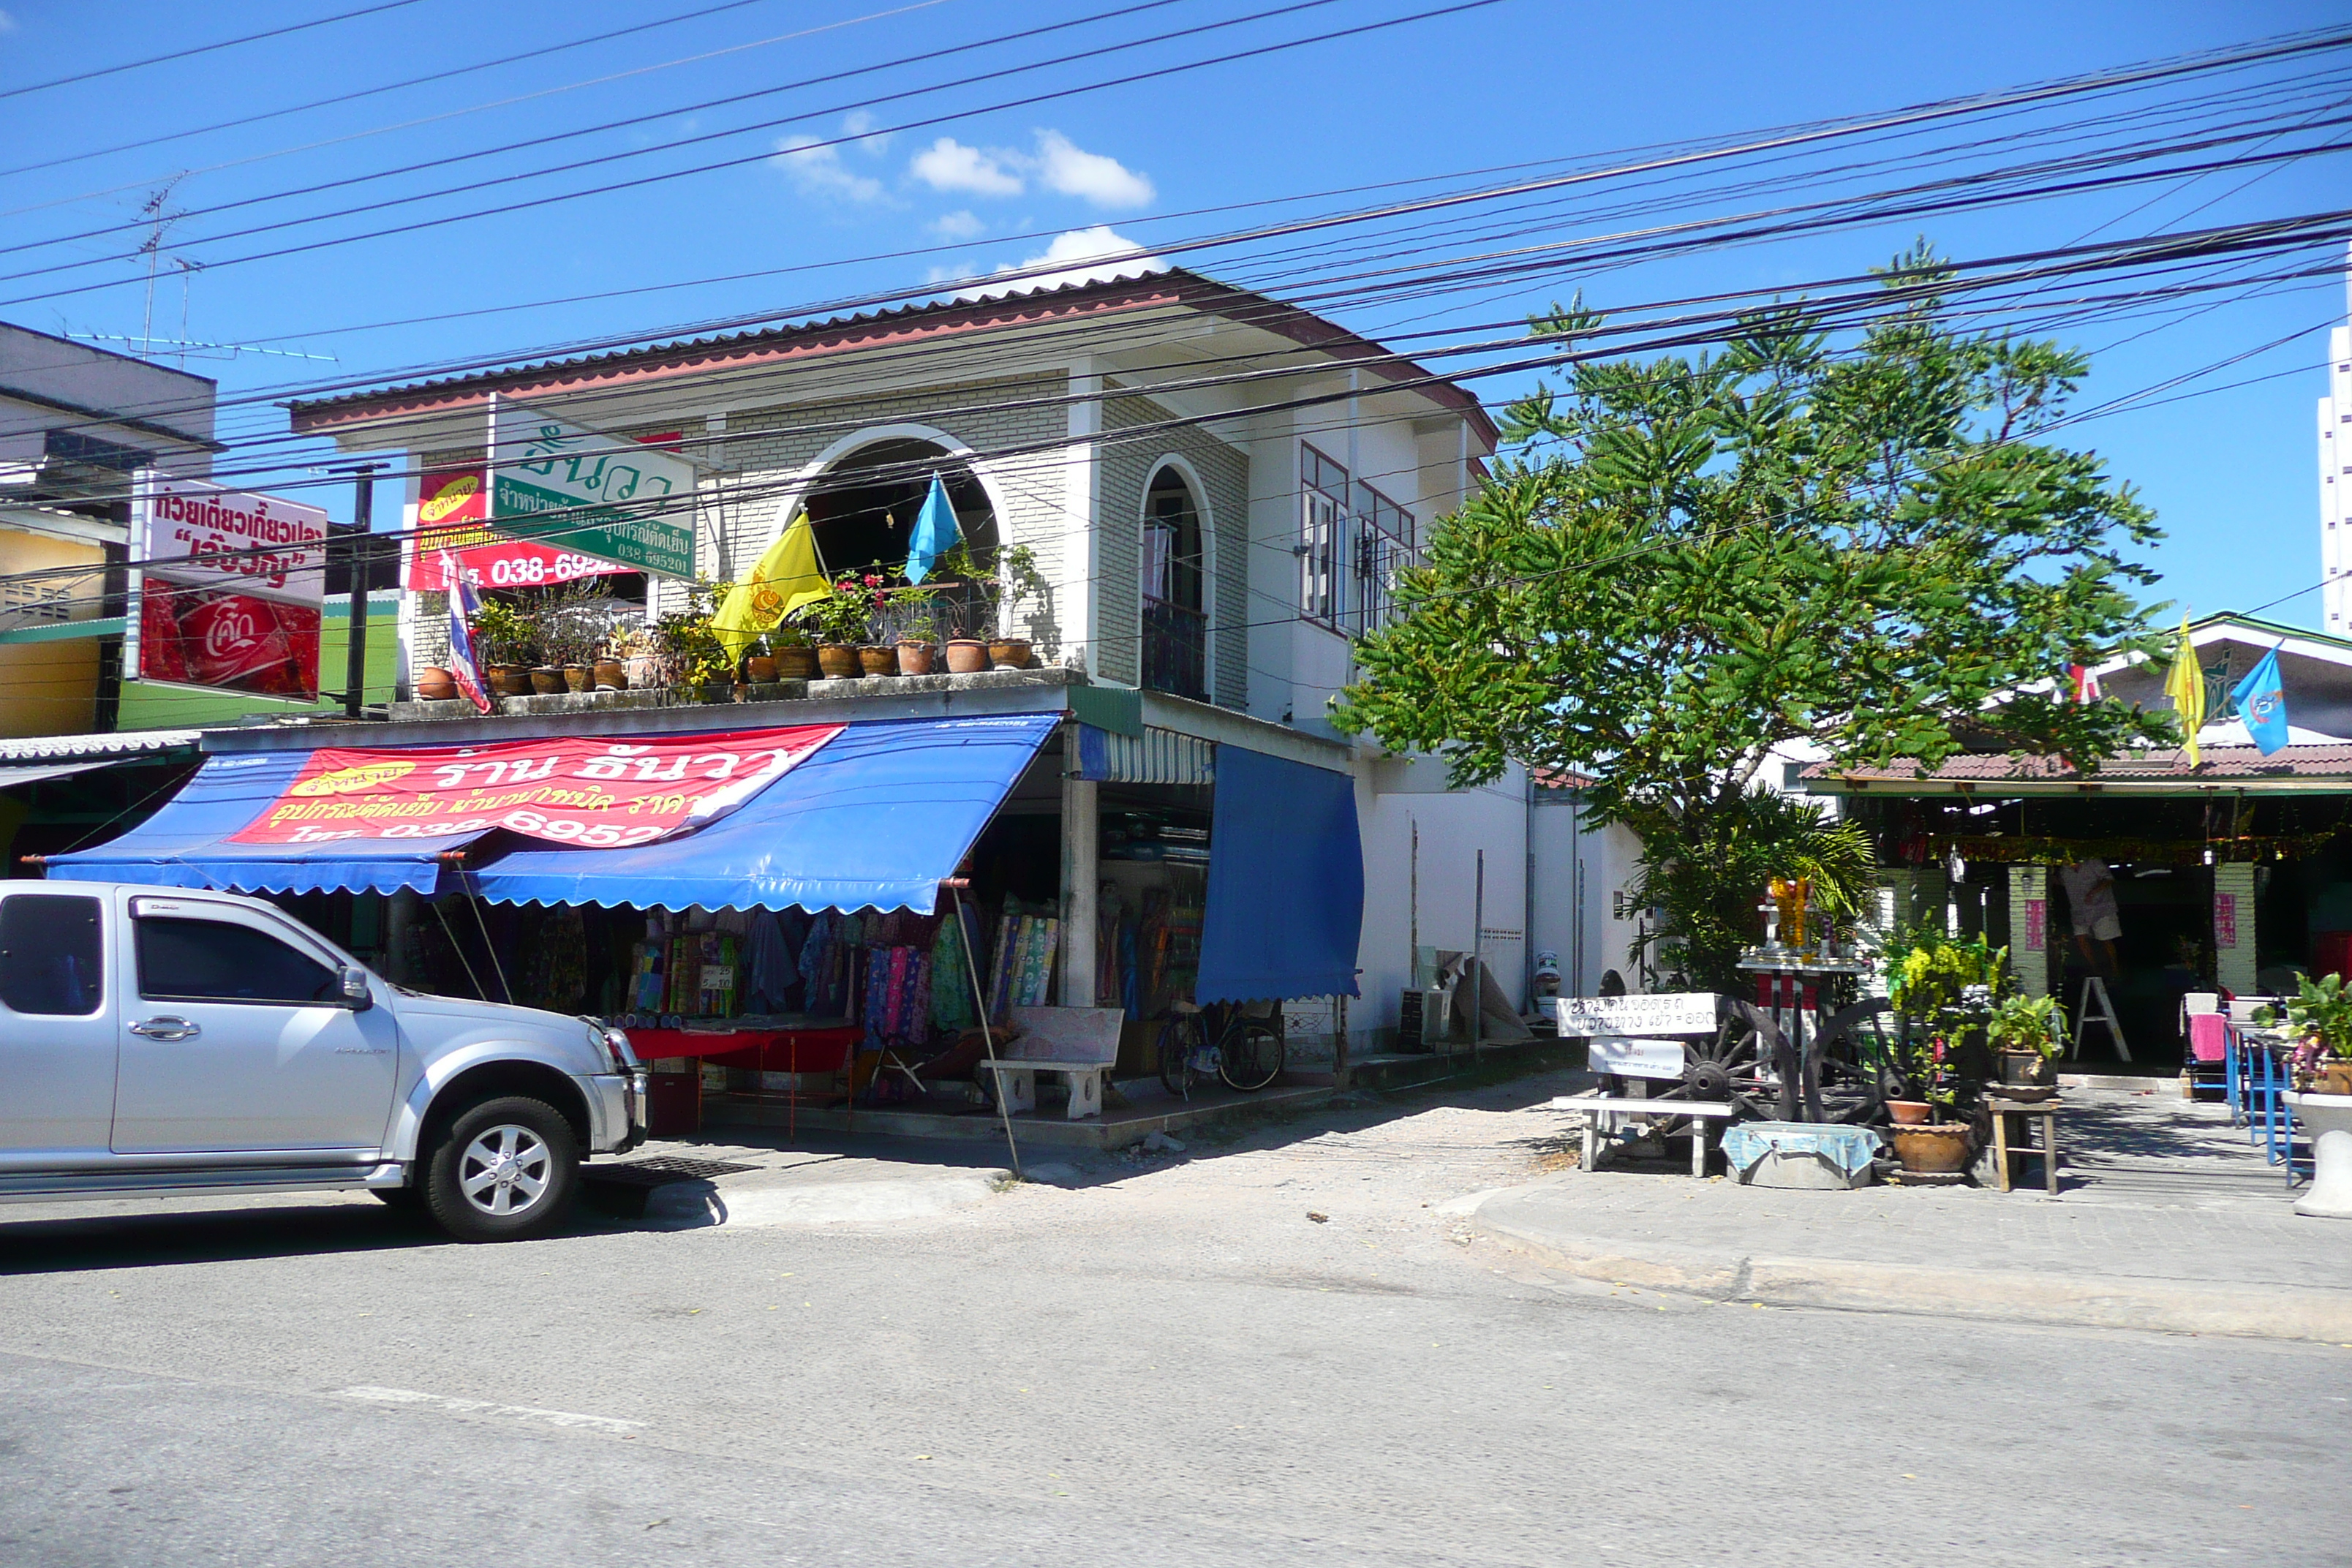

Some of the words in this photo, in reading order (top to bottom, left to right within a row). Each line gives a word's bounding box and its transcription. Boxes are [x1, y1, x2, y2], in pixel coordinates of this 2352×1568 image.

[156, 486, 323, 552] ก๋วยเตียวเกี๊ยวปลา
[439, 551, 484, 587] โร.
[491, 554, 629, 584] 038-6952
[380, 810, 674, 845] 038-6952
